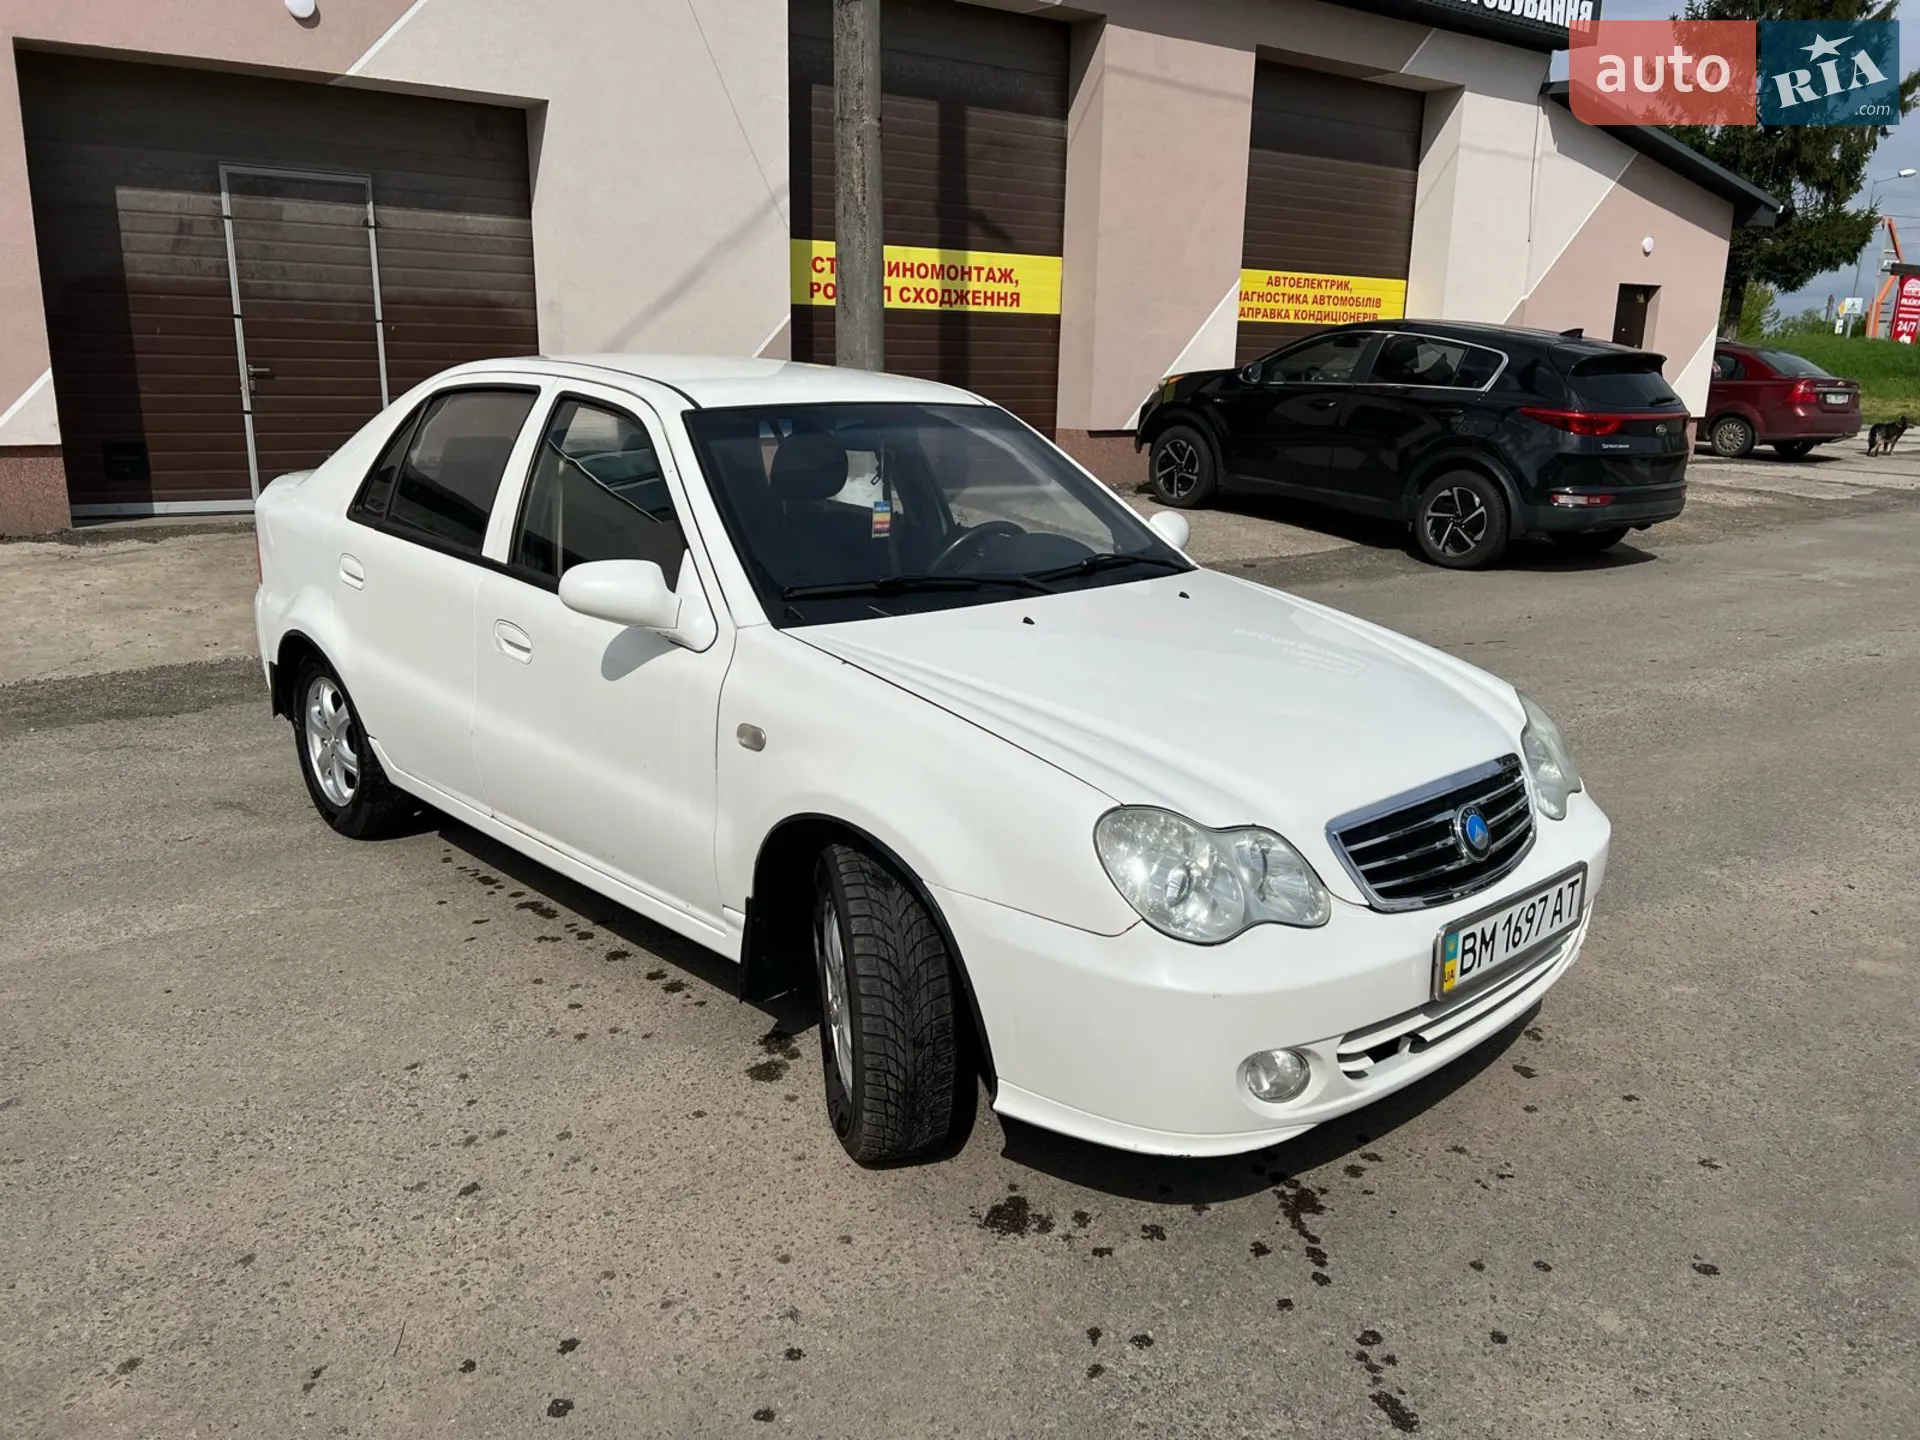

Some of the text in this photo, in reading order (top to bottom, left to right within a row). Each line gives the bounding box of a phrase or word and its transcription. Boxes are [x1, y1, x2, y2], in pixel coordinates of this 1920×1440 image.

[810, 256, 1020, 287] СТ ИНОМОНТАЖ,
[1266, 275, 1353, 293] АВТОЕЛЕКТРИК,
[898, 285, 1021, 308] СХОДЖЕННЯ
[1238, 290, 1382, 308] ІАГНОСТИКА АВТОМОБІЛІВ
[1238, 306, 1379, 324] АПРАВКА КОНДИЦІОНЕРІВ
[1897, 320, 1917, 333] 24/7
[1459, 878, 1580, 977] BM 1697 AT
